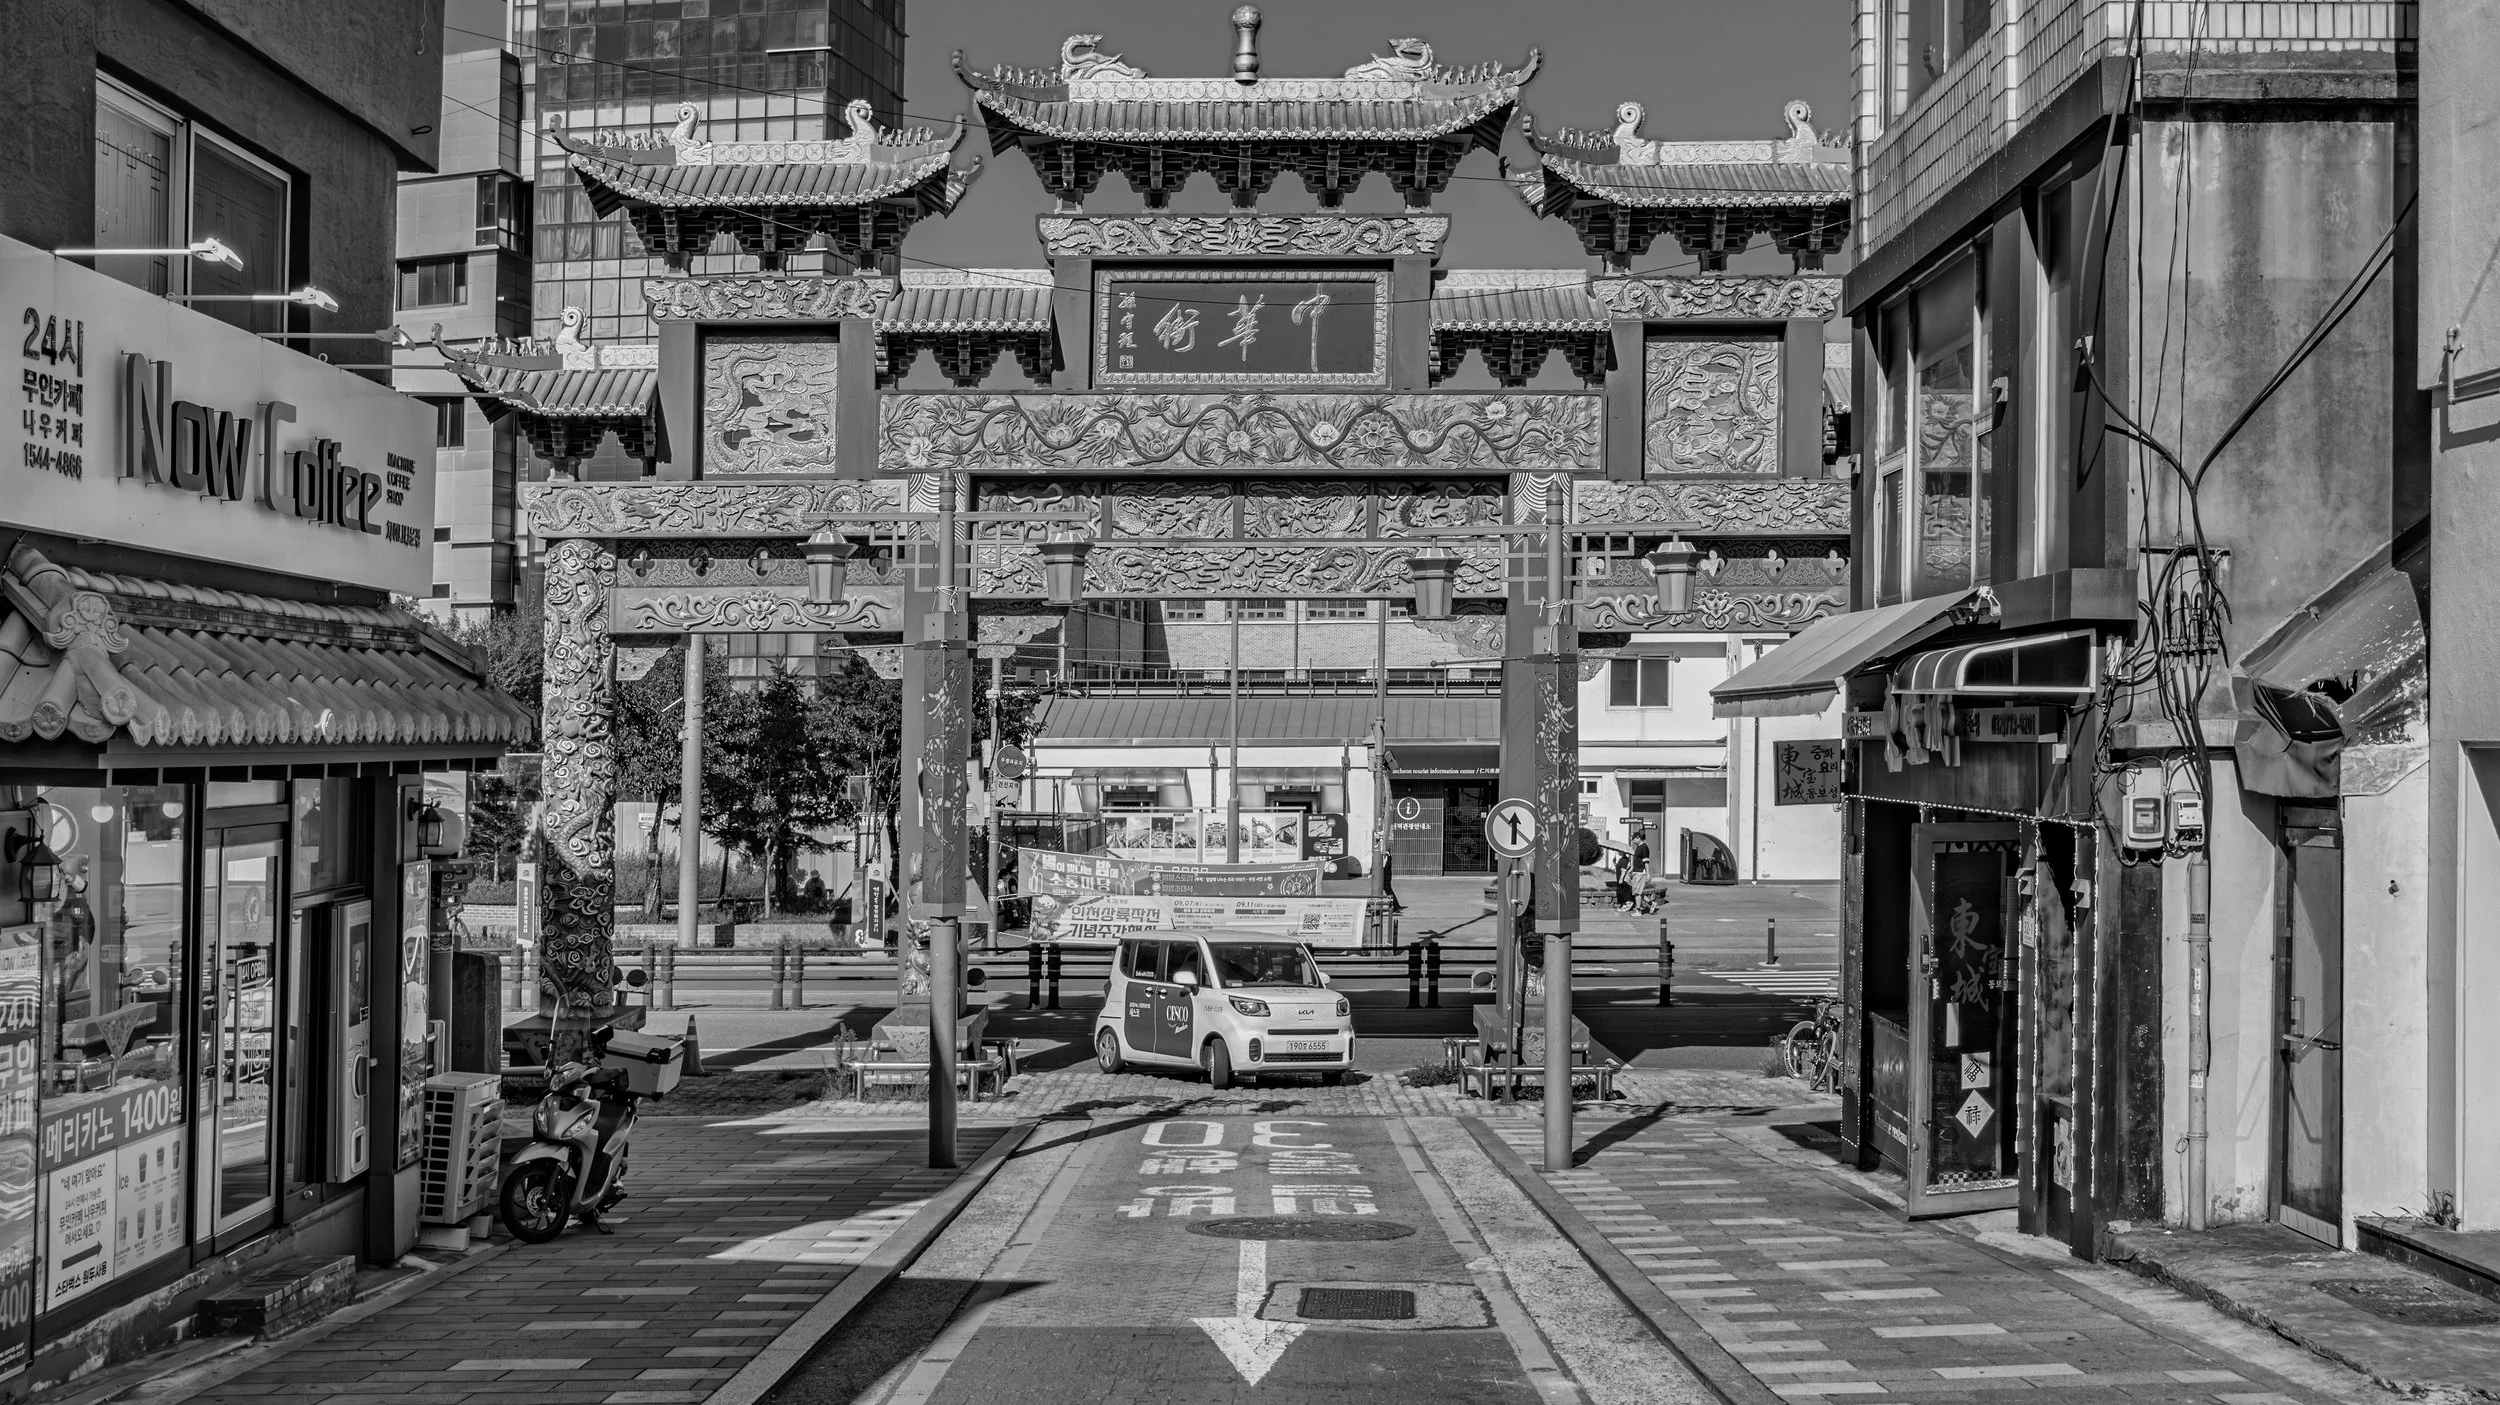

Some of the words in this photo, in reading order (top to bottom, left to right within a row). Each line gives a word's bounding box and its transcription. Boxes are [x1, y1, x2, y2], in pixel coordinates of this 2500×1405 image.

[23, 306, 84, 378] 24시
[22, 368, 84, 418] 무인카페
[126, 352, 253, 501] Now
[23, 442, 83, 481] 1544-4866
[263, 400, 383, 535] Coffee
[386, 470, 411, 492] COFFEE
[1810, 745, 1836, 761] 중화
[1430, 767, 1459, 775] information
[1818, 760, 1838, 773] 요리
[1806, 785, 1838, 800] 동보성
[1042, 854, 1065, 873] 별이
[1071, 905, 1161, 923] 인천상륙작전
[1166, 1005, 1189, 1022] CESCO
[121, 1085, 183, 1138] 1400원
